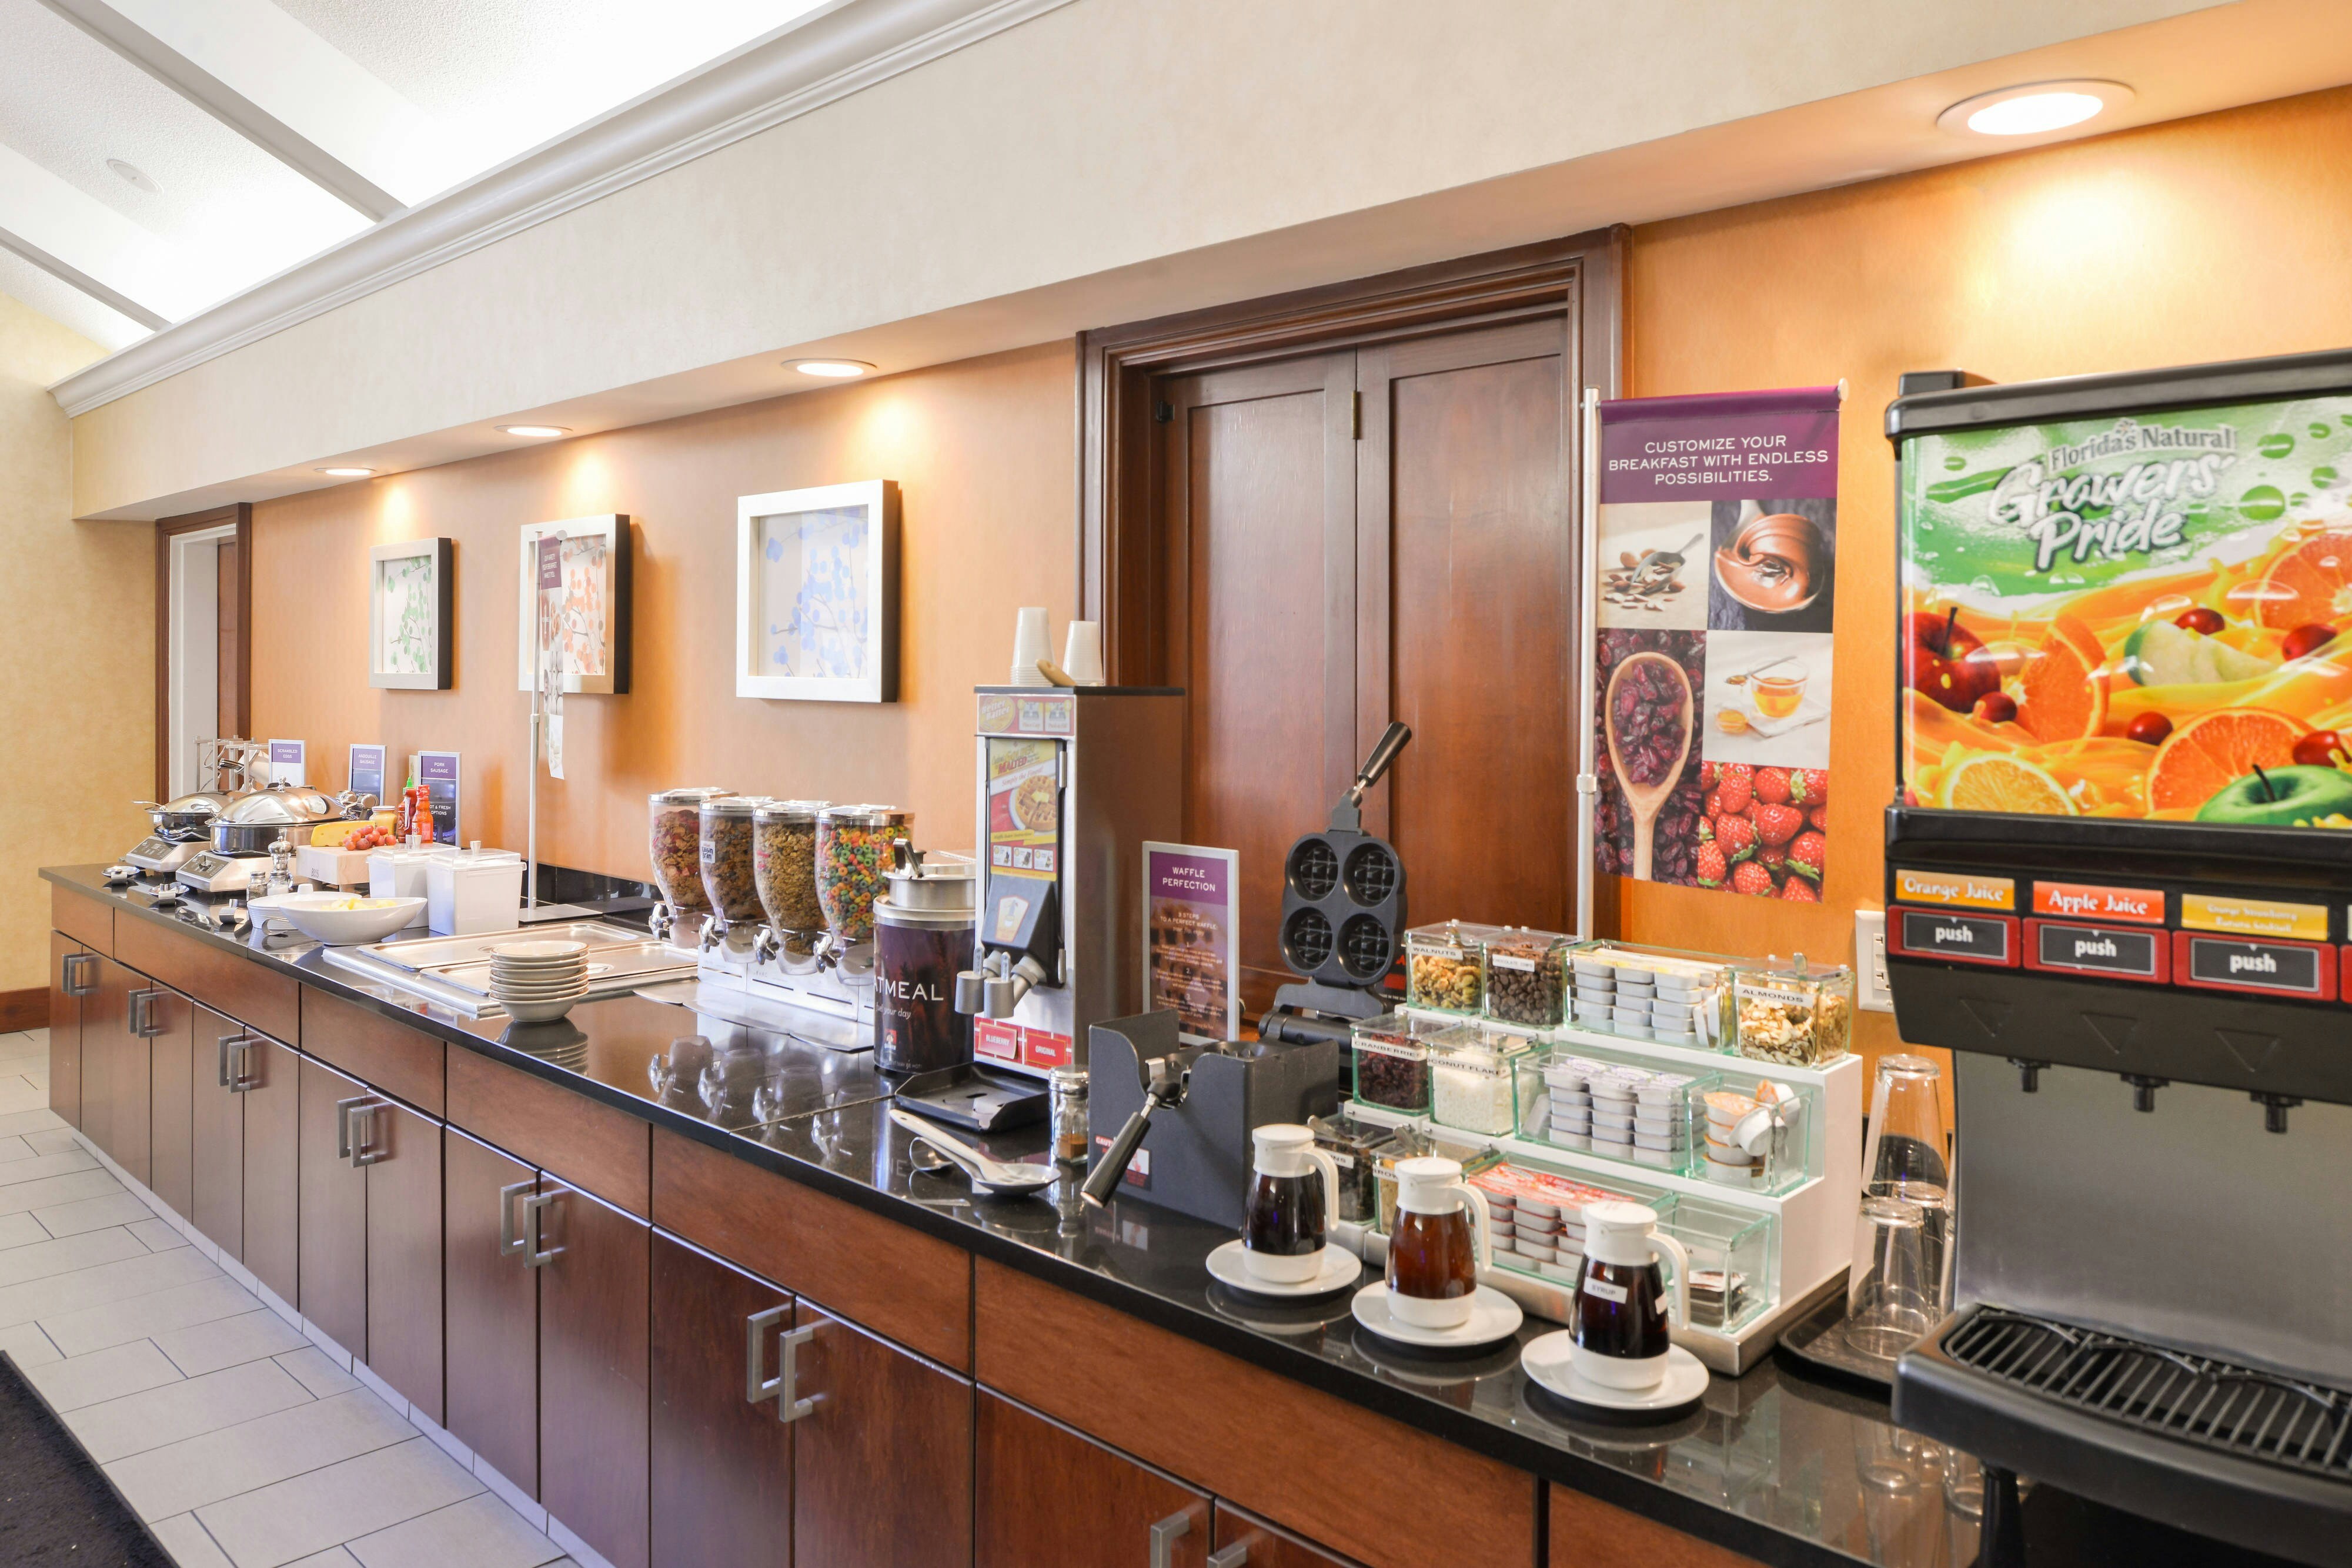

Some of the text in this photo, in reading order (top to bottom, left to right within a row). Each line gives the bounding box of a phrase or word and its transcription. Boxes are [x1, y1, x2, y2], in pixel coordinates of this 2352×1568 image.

[1645, 435, 1787, 454] CUSTOMIZE YOUR
[2142, 427, 2230, 449] Natural
[1609, 450, 1829, 472] BREAKFAST WITH ENDLESS
[1655, 469, 1773, 486] POSSIBILITIES.
[2029, 497, 2189, 573] Pride
[1172, 867, 1205, 878] WAFFLE
[1162, 877, 1215, 892] PERFECTION
[1903, 877, 2004, 902] Orange Juice
[2049, 888, 2148, 915] Apple Juice
[1172, 918, 1195, 926] PERFECT
[1935, 924, 1973, 943] push
[1412, 946, 1456, 957] WALNUTS
[2074, 938, 2117, 958] push
[2230, 952, 2277, 974] push
[874, 975, 944, 1001] ATMEAL
[1743, 989, 1803, 1003] ALMONDS
[898, 1007, 911, 1020] day
[985, 1034, 1010, 1047] BLUEBERRY
[1035, 1045, 1056, 1057] ORIGINAL
[1428, 1058, 1465, 1069] OCONUT
[1095, 1135, 1115, 1147] CAUT
[1591, 1284, 1616, 1295] SYRUP
